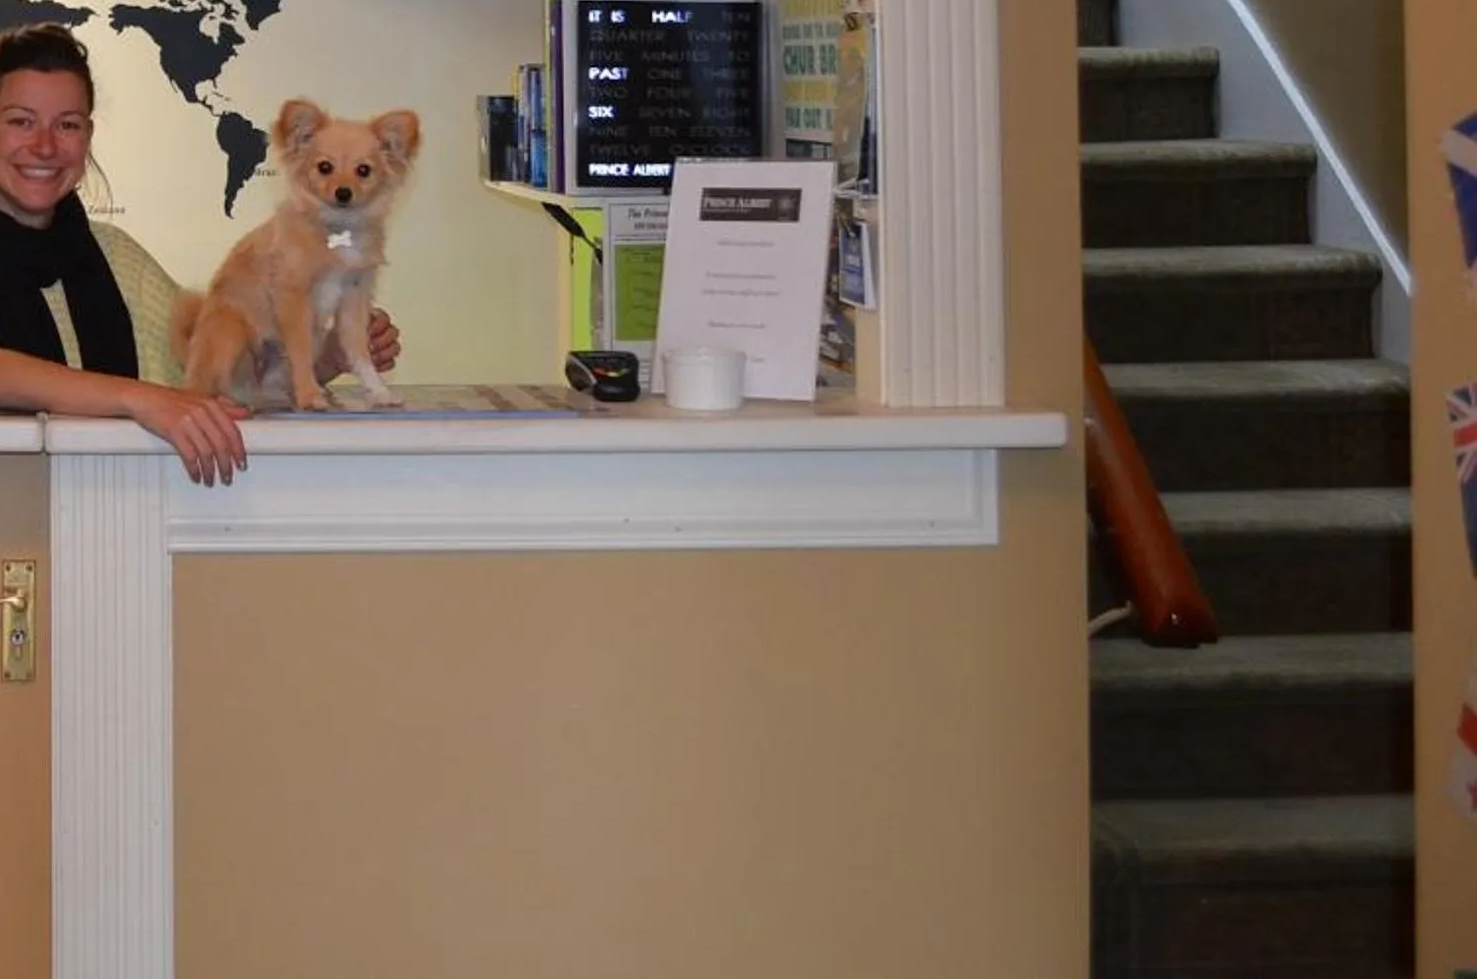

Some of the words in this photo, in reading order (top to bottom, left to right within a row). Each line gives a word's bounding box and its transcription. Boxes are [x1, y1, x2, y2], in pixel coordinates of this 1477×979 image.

[588, 10, 602, 23] IT
[610, 10, 625, 23] IS
[651, 10, 693, 23] HALF
[783, 44, 815, 75] CHUR
[588, 67, 629, 80] PAST
[588, 105, 615, 119] SIX
[588, 163, 630, 176] PRINCE
[633, 163, 671, 176] ALBERT
